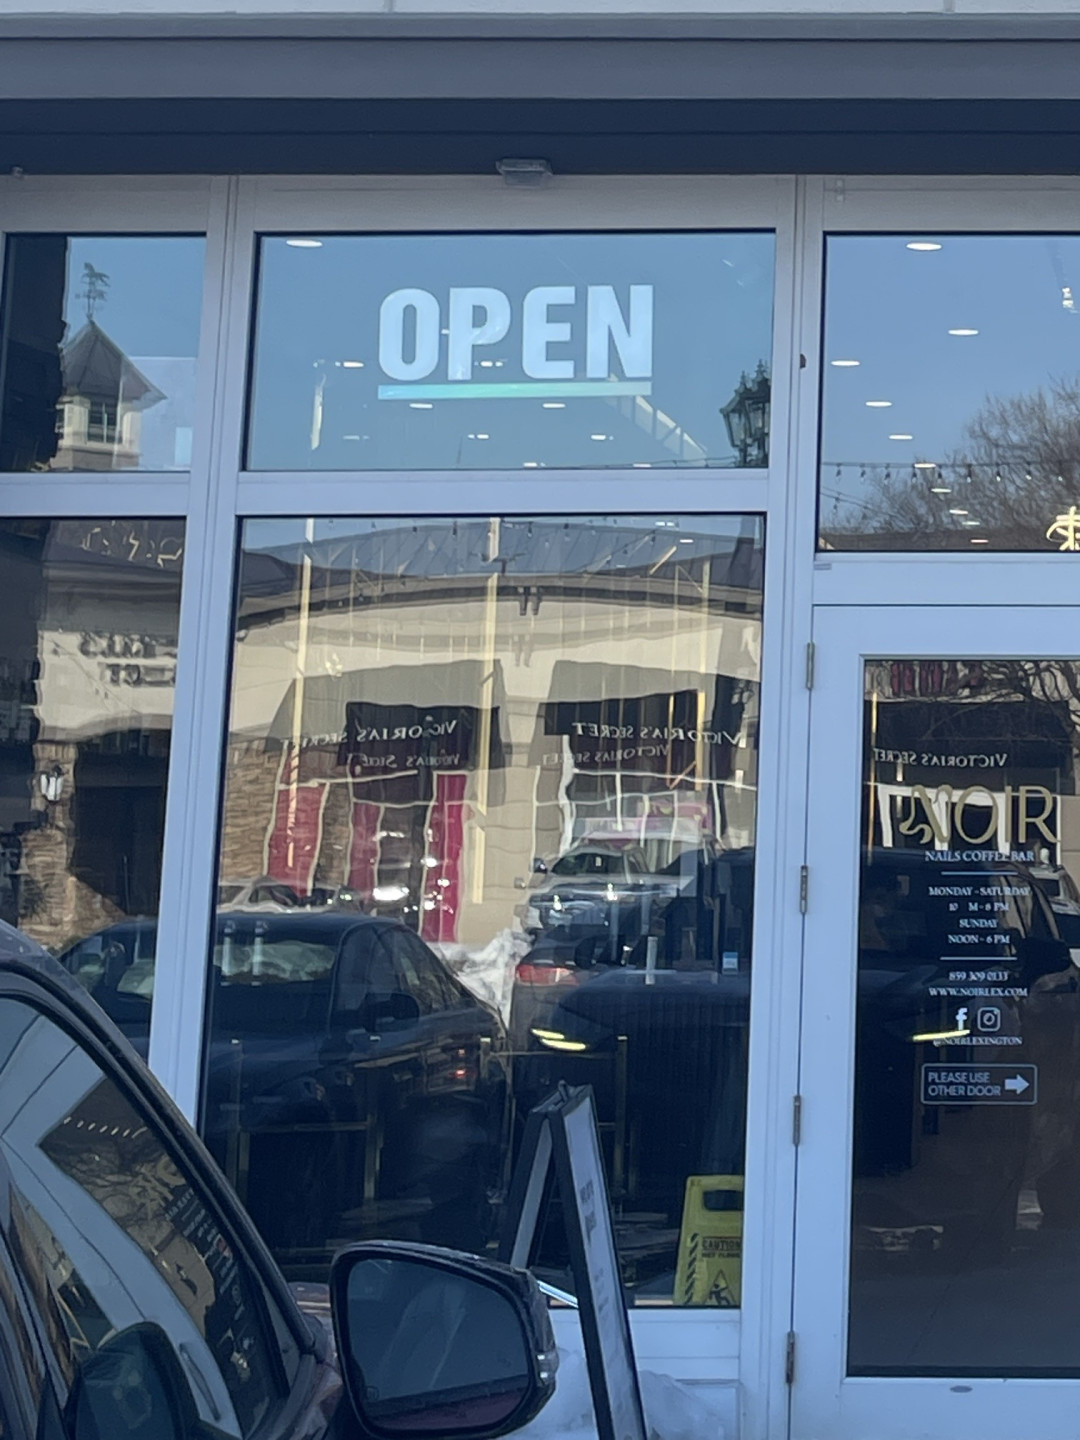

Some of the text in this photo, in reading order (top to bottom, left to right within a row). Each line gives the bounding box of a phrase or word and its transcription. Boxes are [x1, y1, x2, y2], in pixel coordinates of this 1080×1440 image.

[378, 284, 653, 381] OPEN
[899, 784, 1061, 845] NOIR
[925, 850, 1035, 862] NAILS COFFEE BAR
[928, 886, 973, 896] MONDAY
[980, 886, 1032, 896] SATURDAY
[959, 918, 998, 928] SUNDAY
[947, 934, 979, 944] NOON
[994, 934, 1010, 944] PM
[928, 1072, 990, 1083] PLEASE USE
[928, 1085, 1001, 1096] OTHER DOOR
